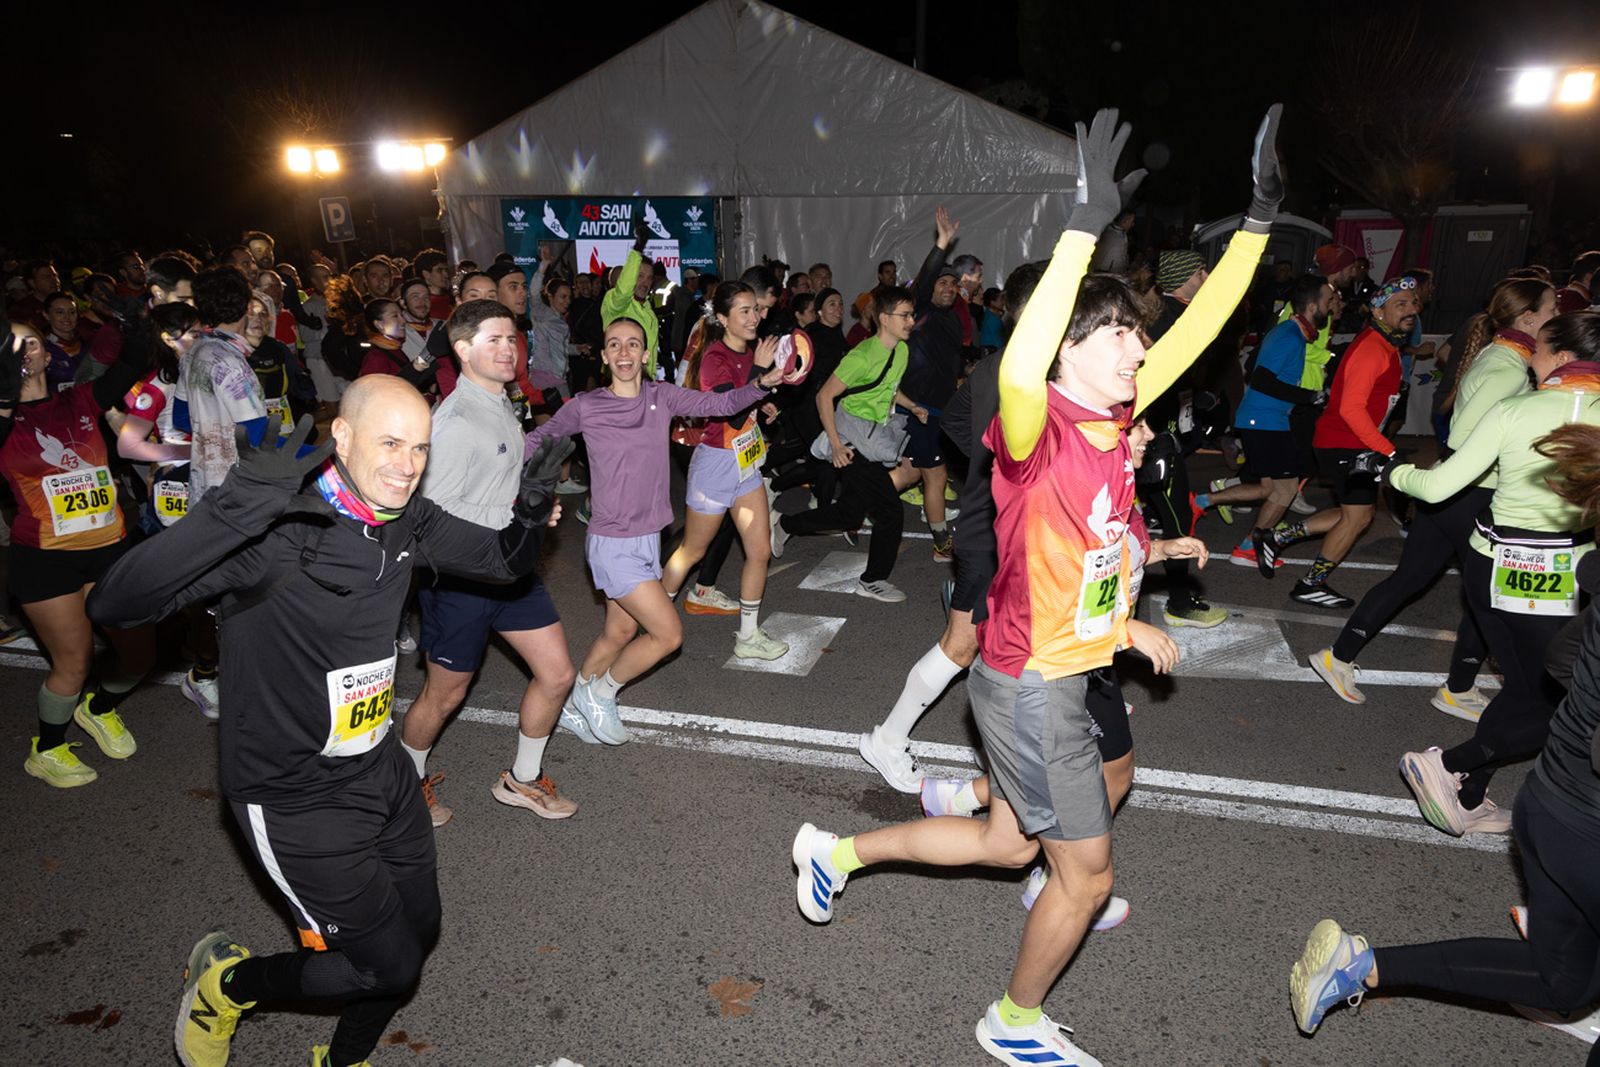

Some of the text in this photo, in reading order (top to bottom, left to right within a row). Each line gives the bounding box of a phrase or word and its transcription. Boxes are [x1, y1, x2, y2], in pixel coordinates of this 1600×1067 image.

[327, 202, 345, 237] P
[581, 204, 632, 221] 43 SAN
[550, 221, 561, 233] 43
[578, 218, 631, 236] ANTÓN
[651, 221, 662, 233] 43
[655, 256, 680, 267] ANT
[681, 257, 714, 265] calderón
[60, 453, 79, 470] 43
[61, 478, 83, 487] NOCHE
[54, 488, 71, 496] SAN
[64, 488, 109, 512] 2306
[1502, 560, 1518, 569] SAN
[1505, 570, 1562, 593] 4622
[356, 672, 384, 688] NOCHE
[344, 690, 364, 704] SAN
